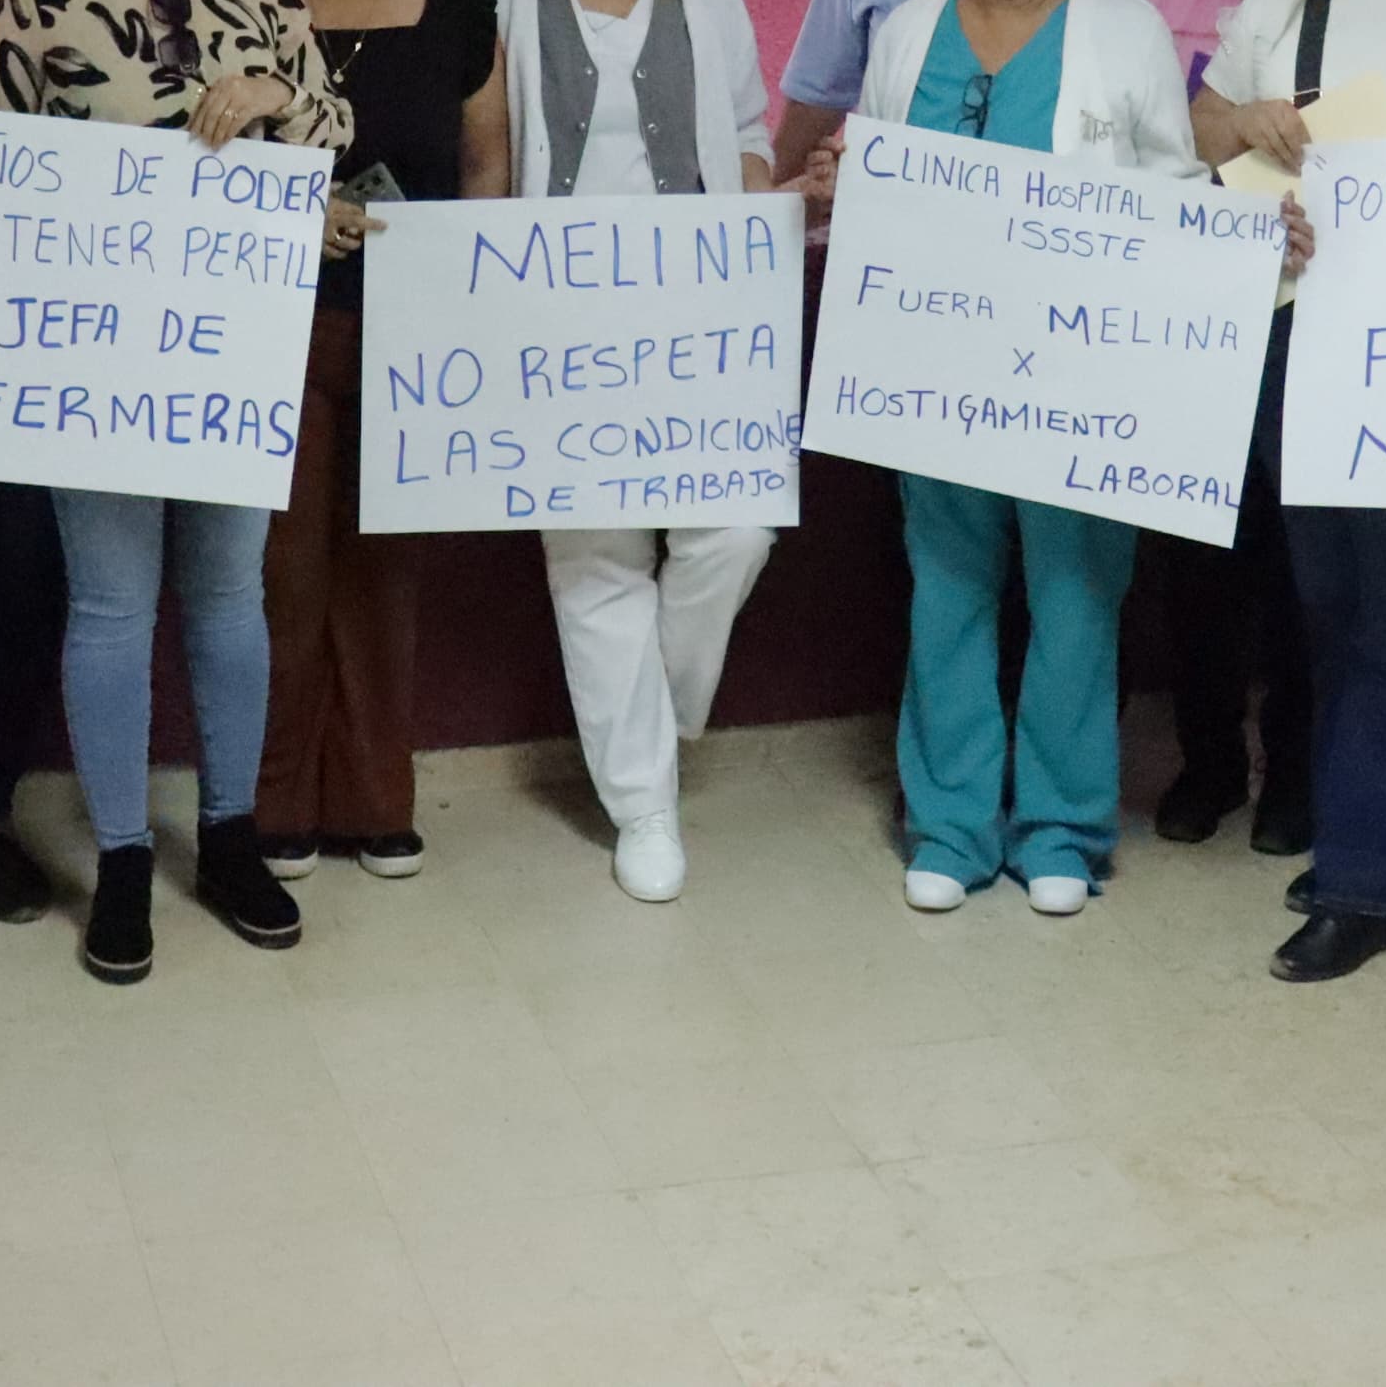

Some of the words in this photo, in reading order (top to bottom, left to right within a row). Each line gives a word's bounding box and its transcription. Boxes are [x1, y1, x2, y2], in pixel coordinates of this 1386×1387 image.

[111, 148, 164, 195] DE
[191, 155, 326, 214] PODER
[863, 135, 999, 196] CLINICA
[1026, 171, 1154, 221] HOSPITAL
[4, 214, 155, 273] TENER
[183, 226, 318, 288] PERFIL
[469, 216, 774, 294] MELINA
[1007, 218, 1146, 261] ISSSTE
[159, 309, 226, 354] DE
[857, 265, 993, 319] FUERA
[1049, 304, 1237, 350] MELINA
[388, 348, 482, 412] NO
[520, 324, 774, 399] RESPETA
[836, 376, 1137, 439] HOSTIGAMIENTO
[397, 430, 526, 484] LAS
[1065, 455, 1241, 509] LABORAL
[506, 485, 575, 517] DE
[599, 469, 785, 510] TRABAJO
